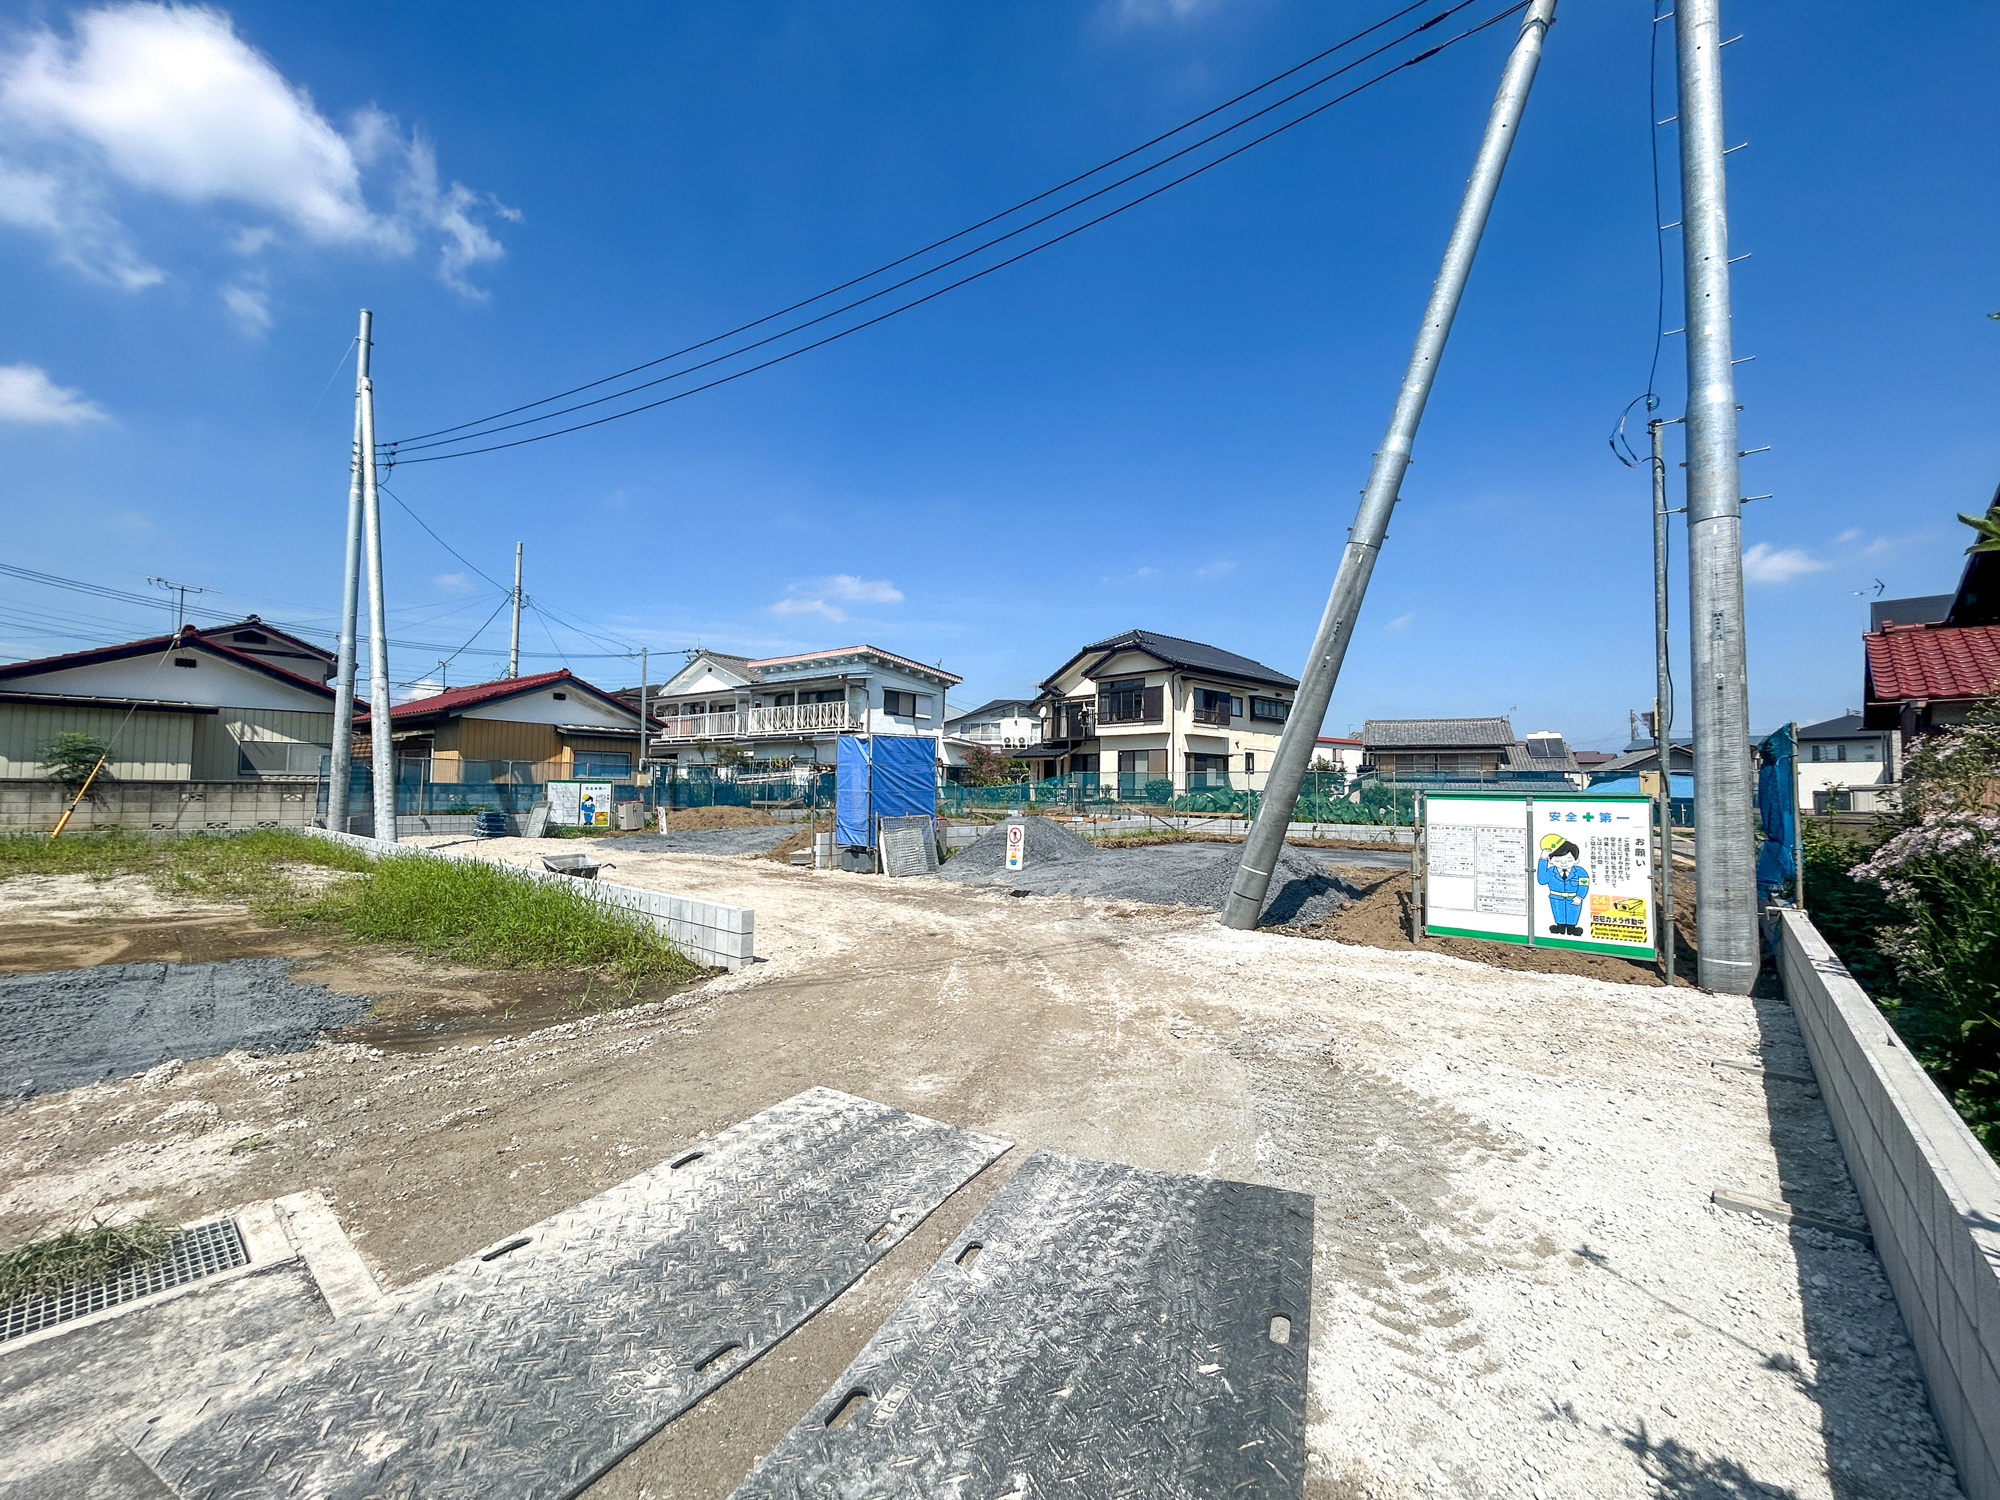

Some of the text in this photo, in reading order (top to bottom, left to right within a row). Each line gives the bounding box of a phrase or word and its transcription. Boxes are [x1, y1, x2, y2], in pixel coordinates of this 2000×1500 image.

[1549, 811, 1630, 823] 安全 第一
[1635, 838, 1646, 867] お願い
[1592, 895, 1607, 904] 24
[1593, 915, 1644, 925] 防犯カメラ作動中
[539, 1375, 646, 1452] FORETECH
